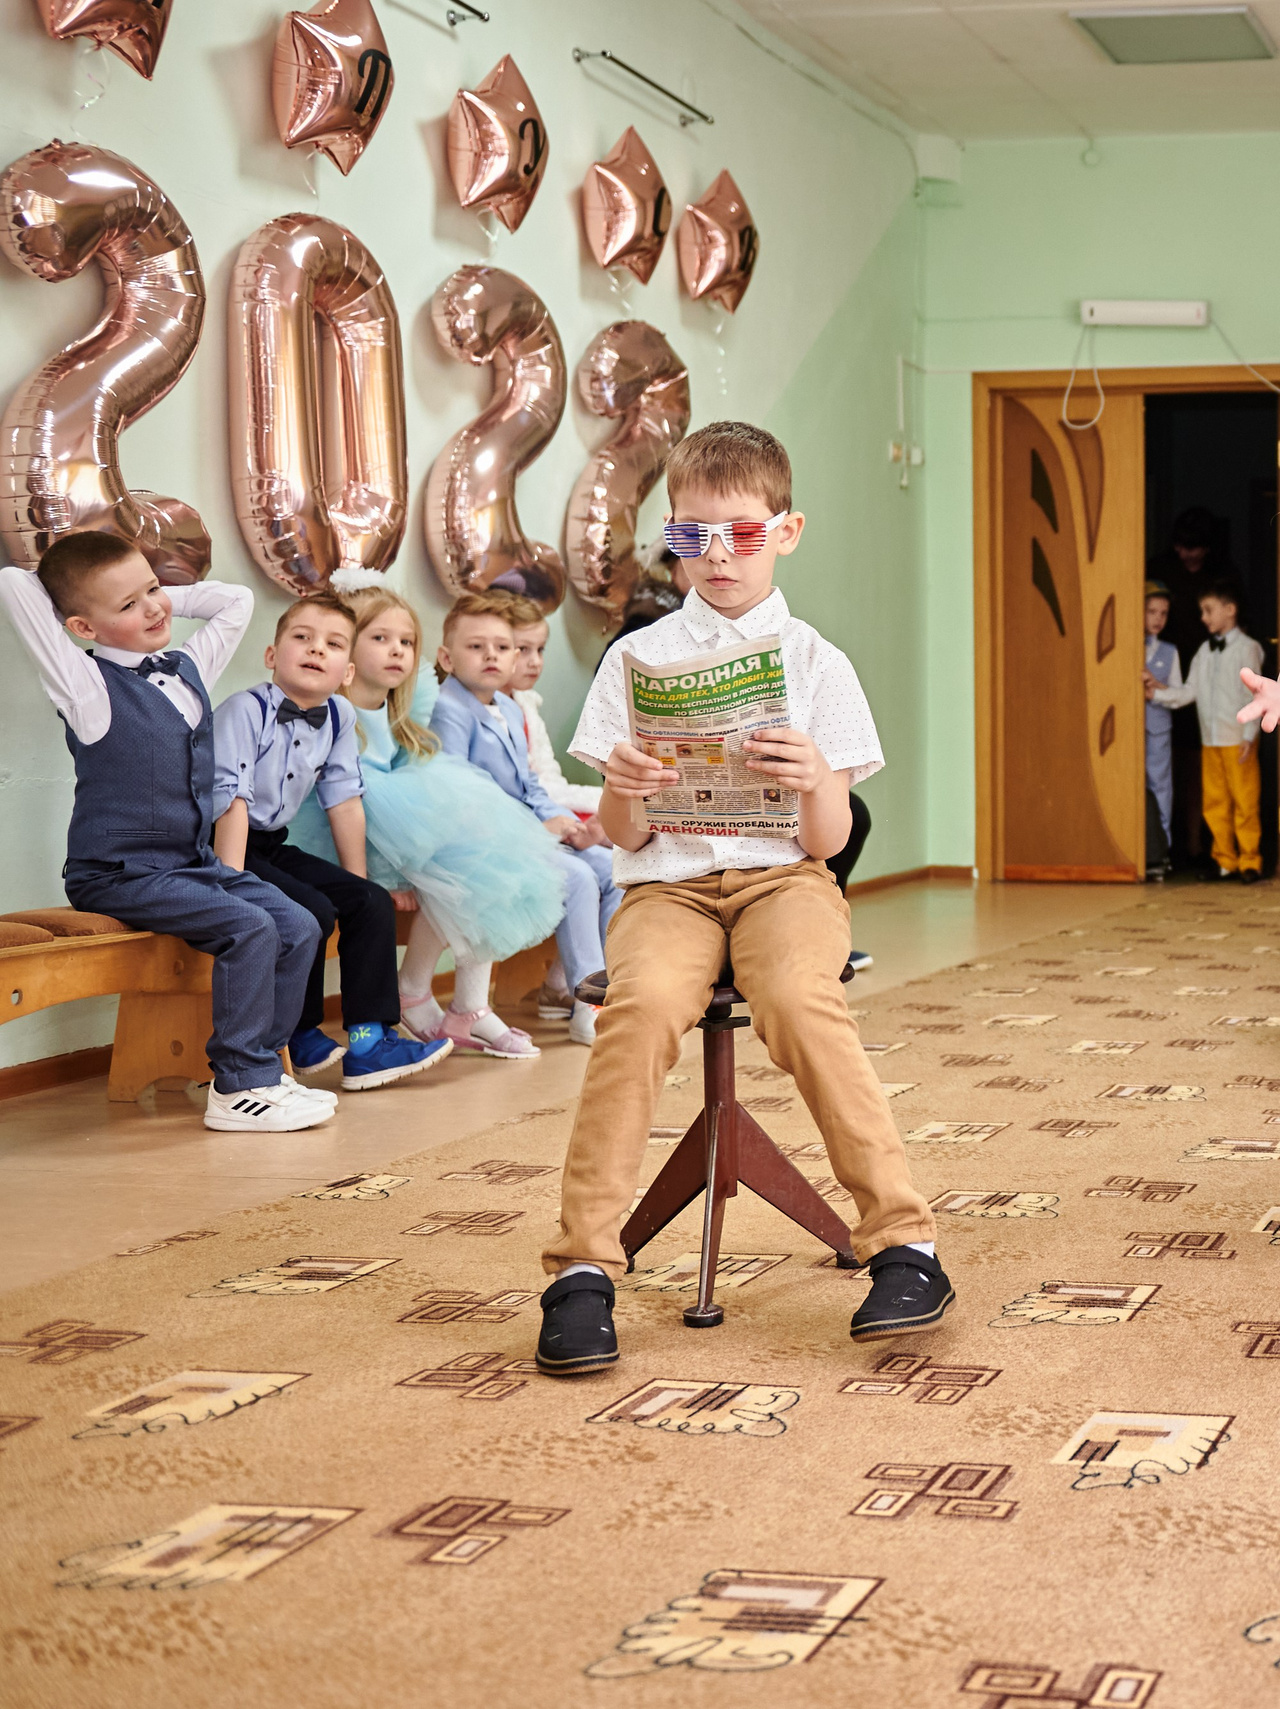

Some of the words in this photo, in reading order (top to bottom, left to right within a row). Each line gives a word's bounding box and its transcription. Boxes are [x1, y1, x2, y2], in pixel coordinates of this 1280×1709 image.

[633, 655, 761, 692] НАРОДНАЯ
[769, 652, 783, 668] М
[635, 688, 666, 700] ГАЗЕТА
[668, 693, 689, 701] ДЛЯ
[691, 689, 710, 698] ТЕХ,
[712, 683, 731, 693] КТО
[732, 673, 765, 688] ЛЮБИТ
[638, 699, 680, 709] ДОСТАВКА
[682, 695, 731, 708] БЕСПЛАТНО!
[739, 683, 769, 696] ЛЮБОЙ
[689, 698, 746, 715] БЕСПЛАТНОМУ
[748, 691, 780, 702] НОМЕРУ
[649, 824, 739, 836] АДЕНОВИН
[681, 820, 727, 828] ОРУЖИЕ
[729, 820, 775, 829] ПОБЕДЫ
[776, 820, 799, 829] НАД
